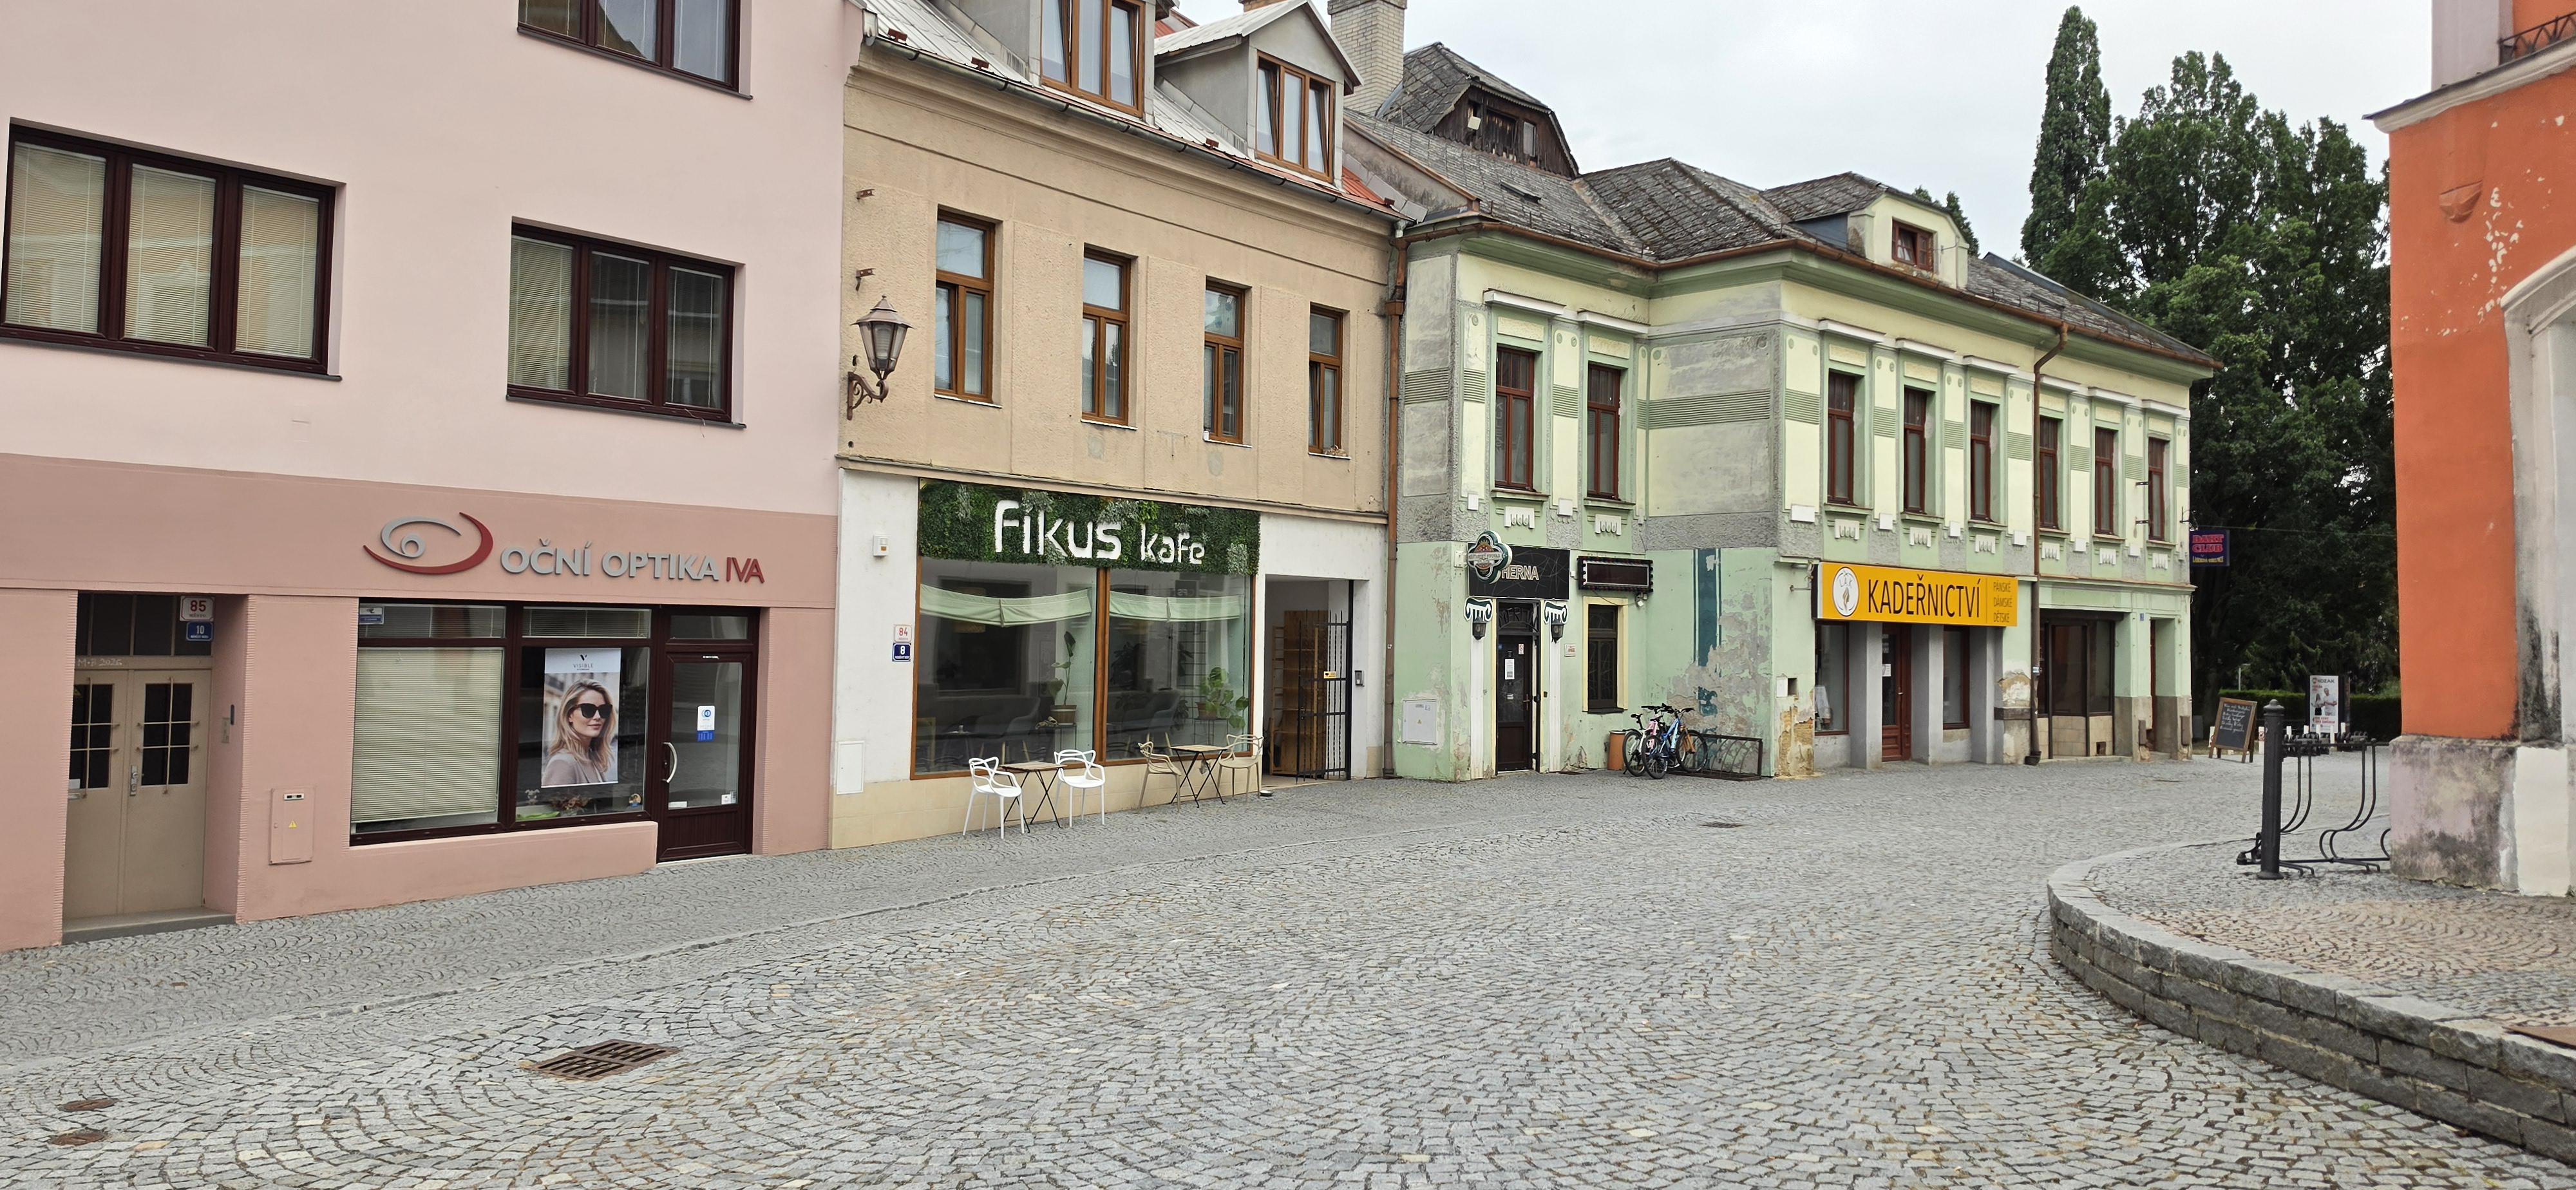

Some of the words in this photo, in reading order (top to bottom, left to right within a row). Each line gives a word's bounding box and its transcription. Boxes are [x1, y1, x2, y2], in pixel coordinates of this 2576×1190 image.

[1140, 522, 1206, 565] kafe
[2192, 543, 2223, 553] CLUB
[500, 538, 592, 576] OČNÍ
[601, 551, 719, 581] OPTIKA
[726, 556, 765, 583] IVA
[1501, 564, 1540, 581] HERNA
[1993, 580, 2011, 592] PÁNSKÉ
[1868, 574, 1981, 618] KADEŘNICTVÍ
[1994, 595, 2012, 608] DÁMSKÉ
[190, 600, 207, 612] 85
[1994, 610, 2010, 623] DĚTSKÉ
[196, 625, 205, 634] 10
[899, 627, 908, 636] 84
[900, 645, 905, 655] 8
